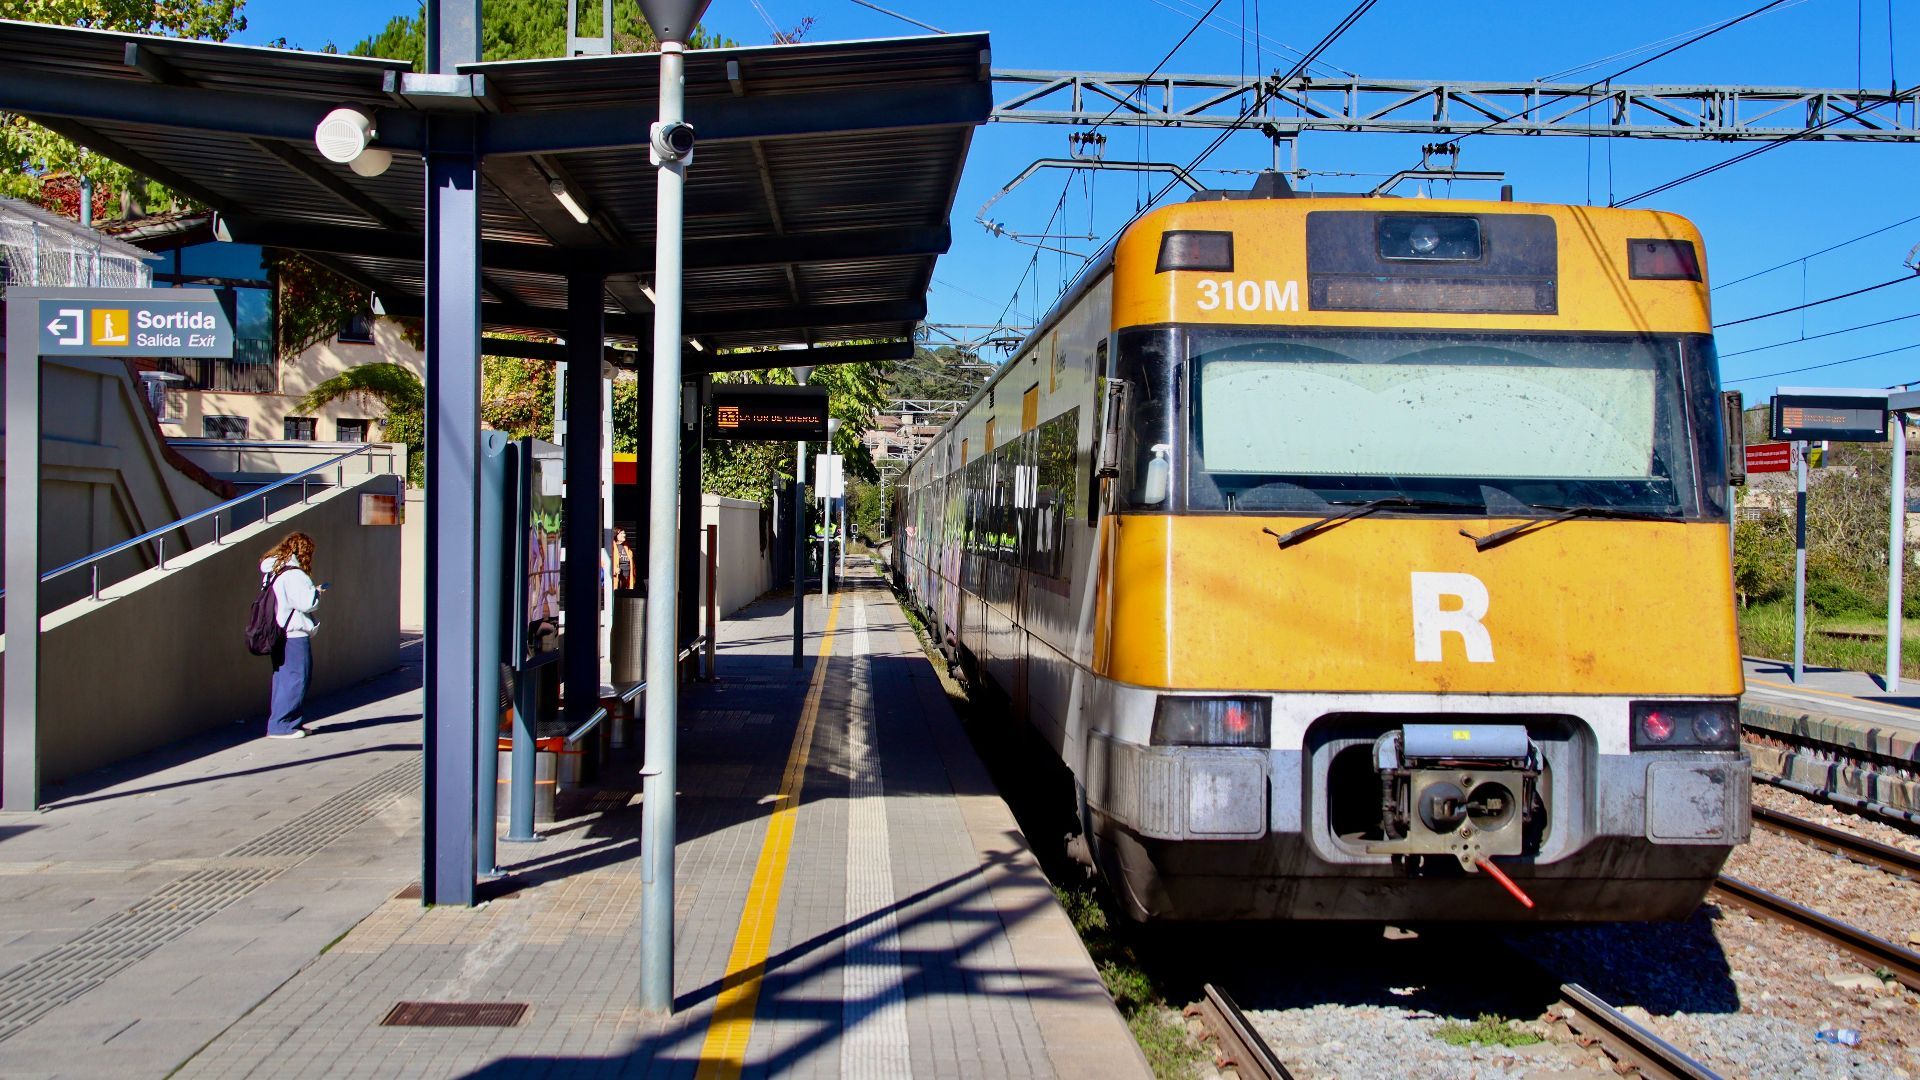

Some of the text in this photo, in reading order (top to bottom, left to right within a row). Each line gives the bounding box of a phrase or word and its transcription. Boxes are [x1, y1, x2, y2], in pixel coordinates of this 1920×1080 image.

[1197, 279, 1299, 311] 310M
[137, 310, 216, 329] Sortida
[188, 334, 216, 347] Exit
[1411, 571, 1496, 663] R
